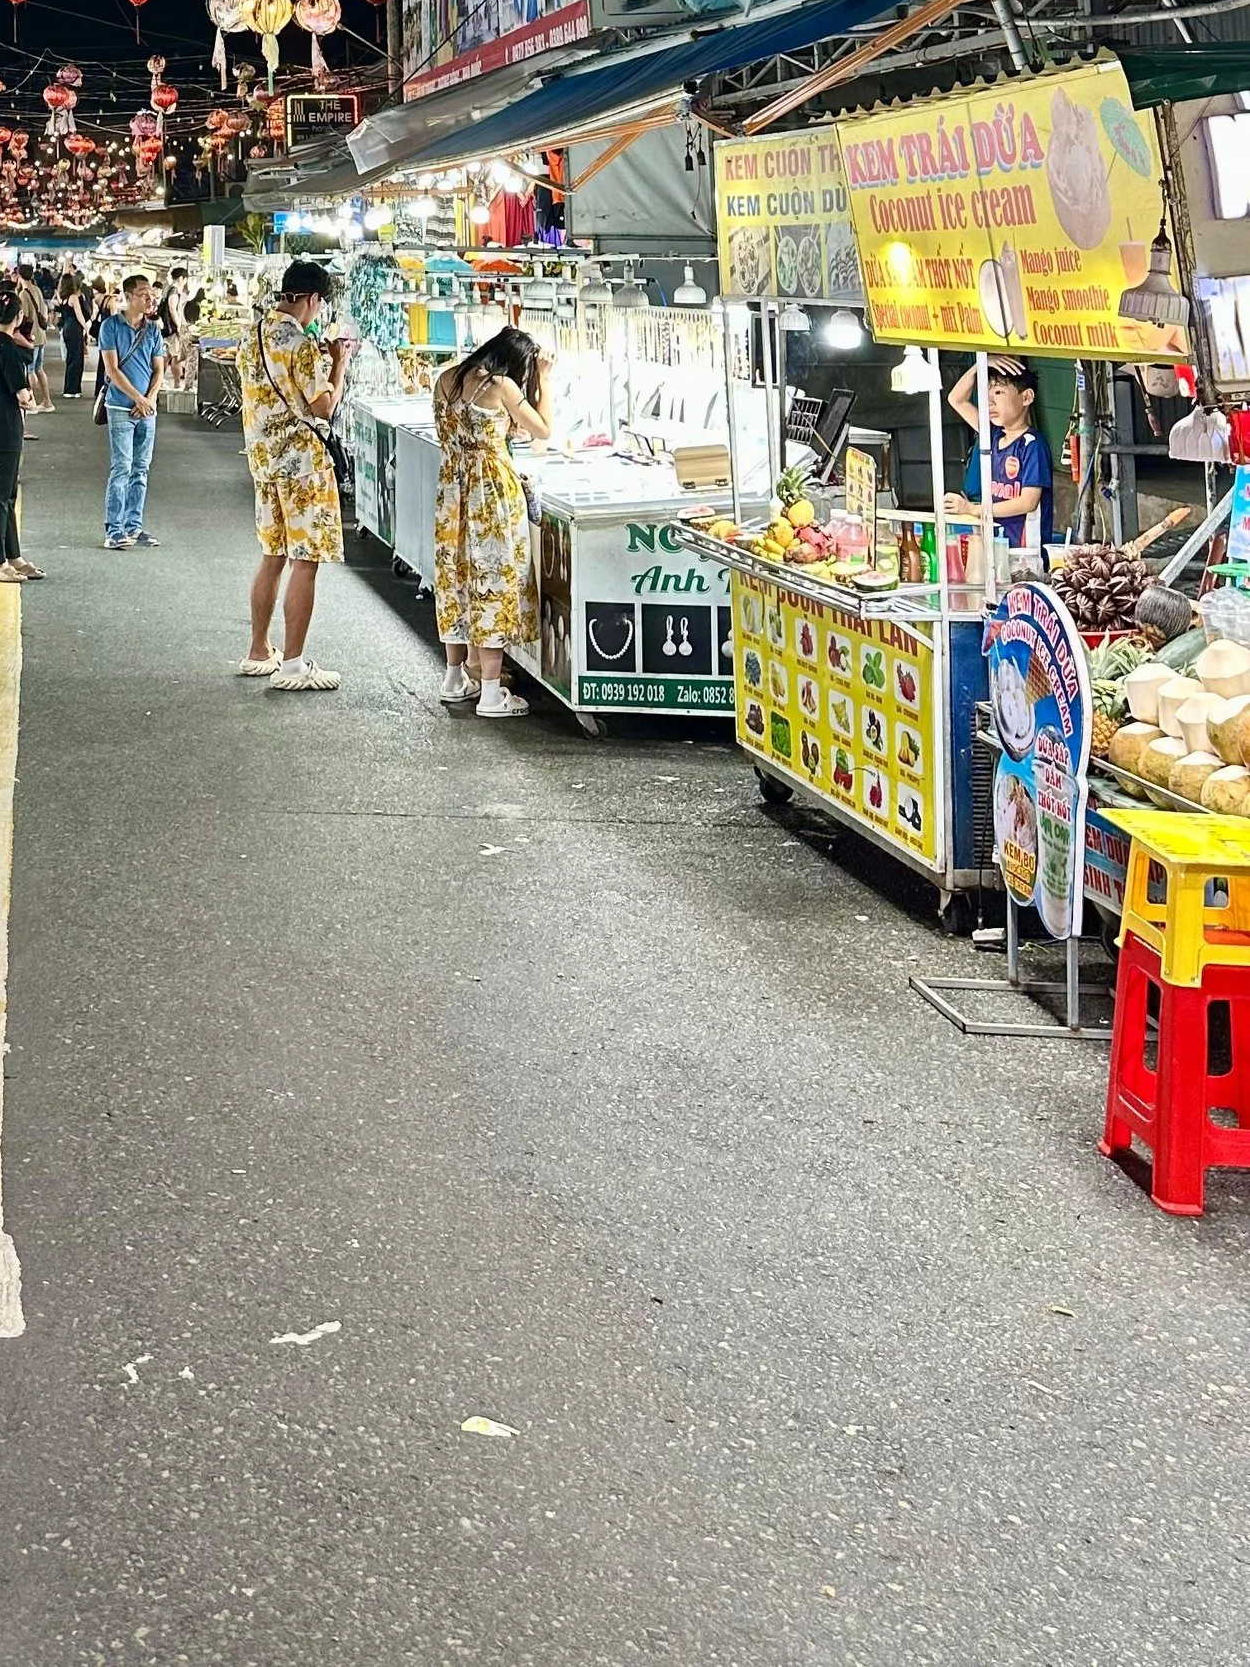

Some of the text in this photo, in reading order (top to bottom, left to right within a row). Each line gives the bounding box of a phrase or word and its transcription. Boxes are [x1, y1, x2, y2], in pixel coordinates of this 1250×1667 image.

[308, 112, 353, 123] EMPIRE
[319, 99, 342, 110] THE
[845, 102, 1045, 191] KEM TRÁI DỪA
[725, 152, 759, 181] KEM
[764, 143, 811, 184] CUỘN
[726, 193, 760, 217] KEM
[766, 185, 815, 220] CUỘN
[869, 183, 1037, 234] Coconut ice cream
[952, 242, 976, 290] NỐT
[1020, 245, 1082, 277] Mango juice
[1026, 285, 1111, 315] Mango smoothie
[872, 299, 900, 333] Special
[901, 302, 932, 331] coconut
[940, 301, 957, 333] mix
[957, 301, 985, 335] Palm
[1033, 320, 1120, 348] Coconut milk
[630, 565, 711, 596] Anh
[1007, 589, 1031, 619] KEM
[582, 682, 600, 700] ĐT:
[601, 683, 624, 701] 0939
[627, 683, 645, 701] 192
[647, 684, 665, 702] 018
[677, 685, 701, 703] Zalo:
[703, 686, 727, 704] 0852
[1001, 620, 1073, 738] COCONUT ICE CREAM
[1003, 839, 1022, 864] KEM
